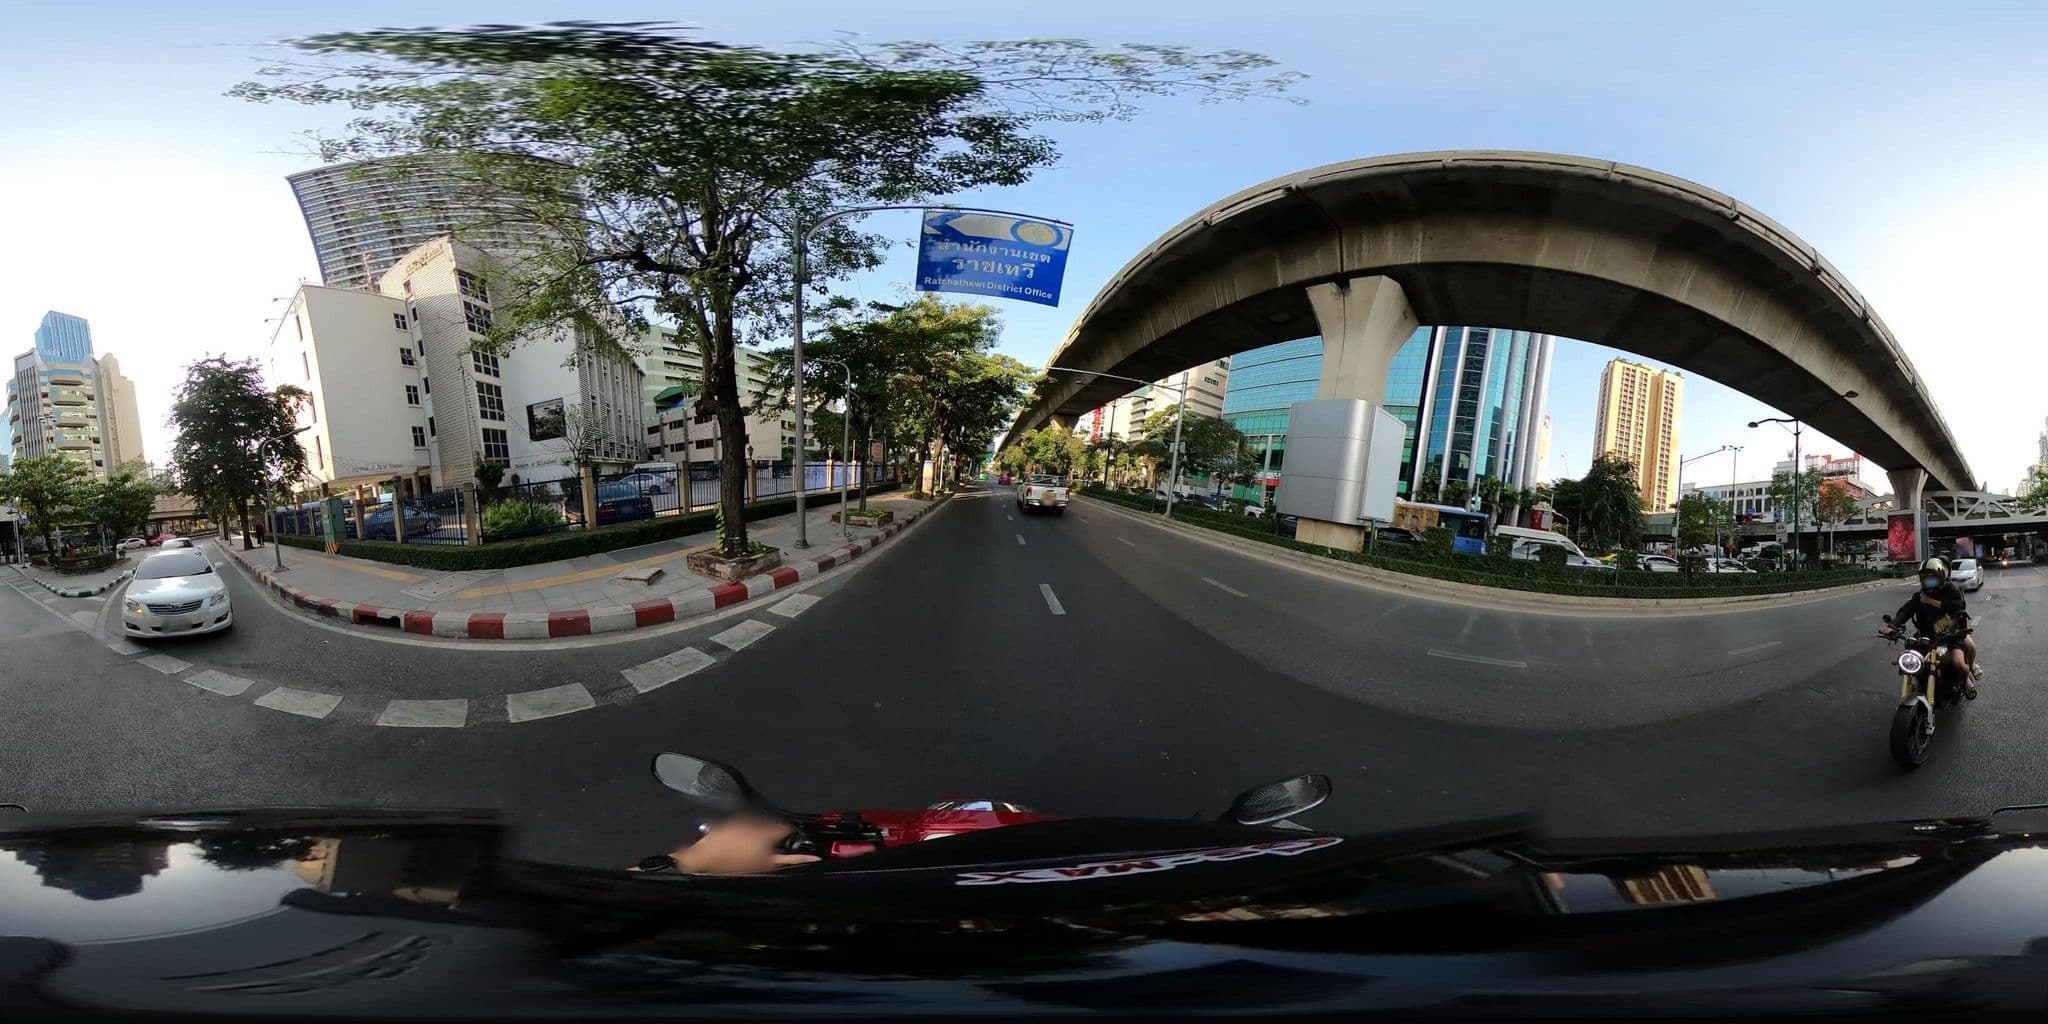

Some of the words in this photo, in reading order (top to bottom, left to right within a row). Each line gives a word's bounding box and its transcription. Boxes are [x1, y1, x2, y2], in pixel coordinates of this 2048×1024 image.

[938, 239, 1050, 263] สำนักงานเขต
[953, 258, 1035, 278] ราชเทวี
[988, 282, 1022, 293] District
[1026, 287, 1052, 299] Office
